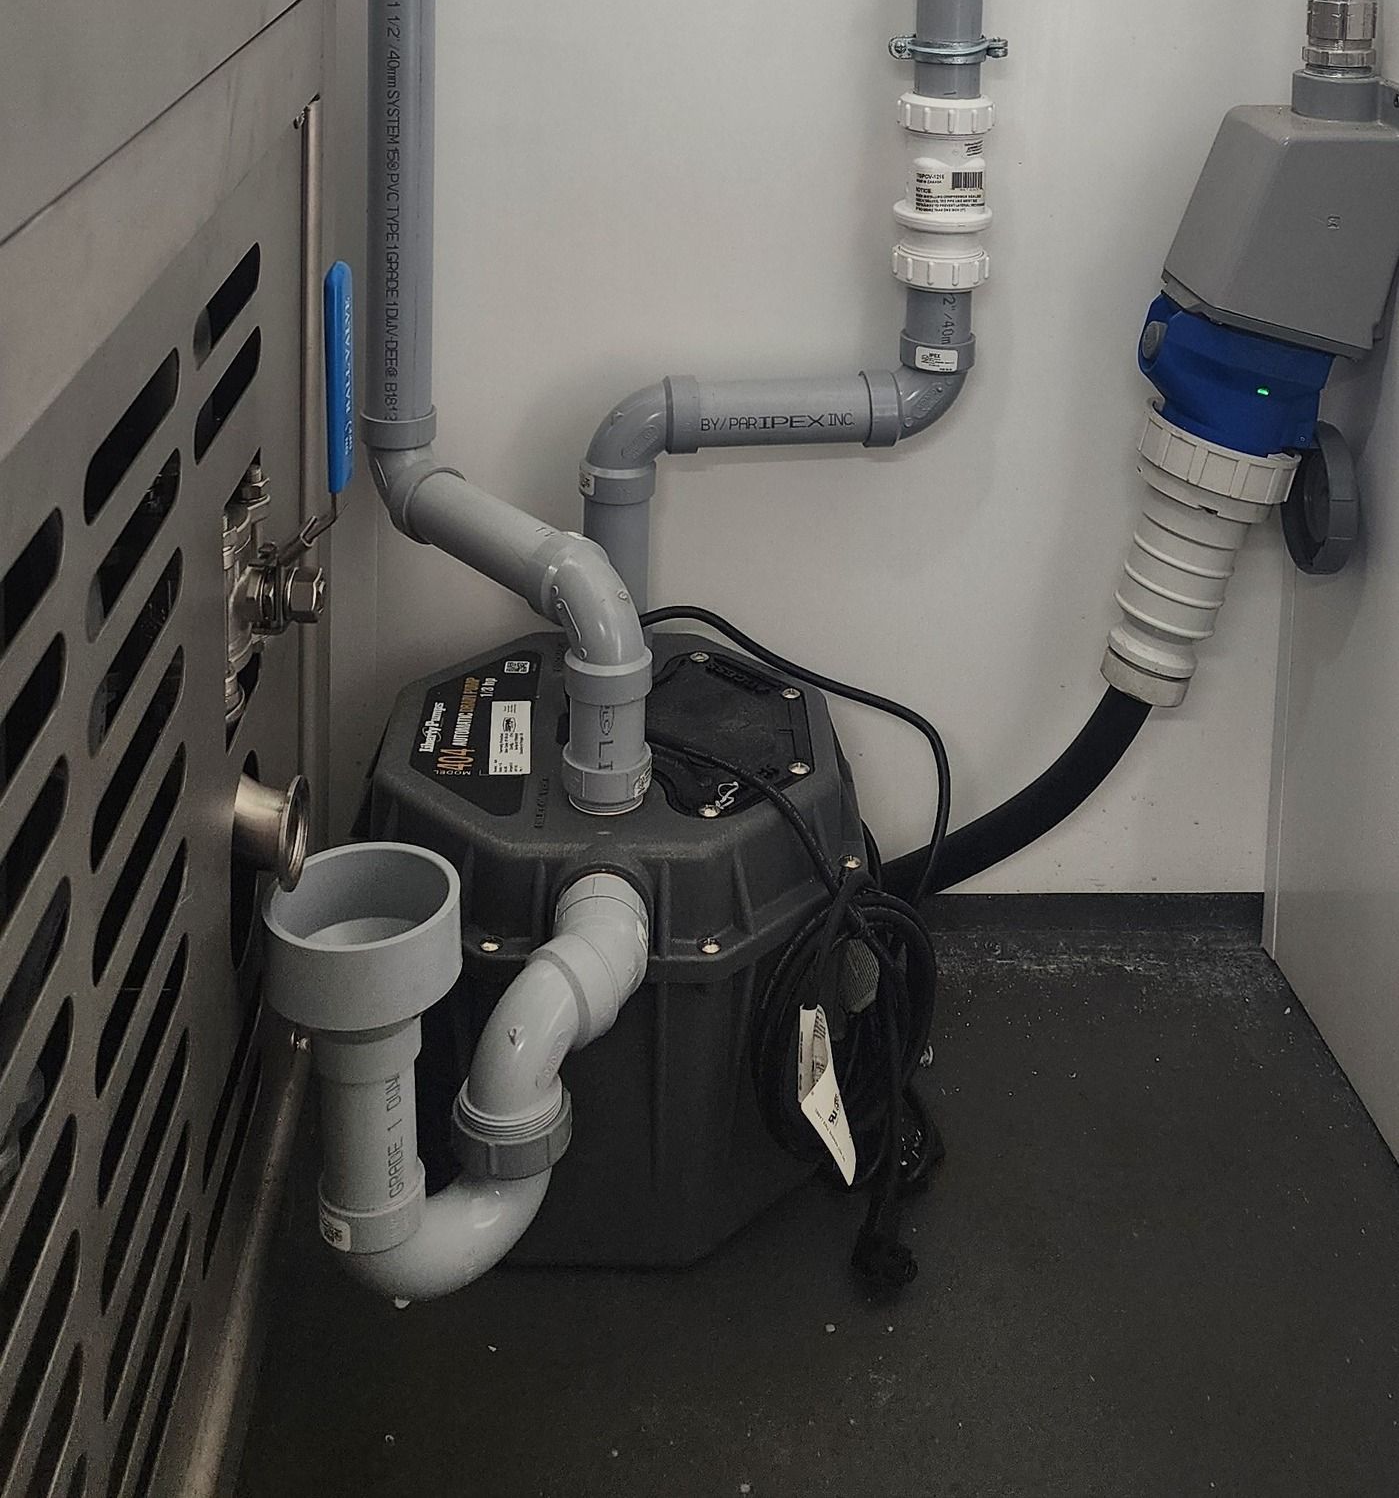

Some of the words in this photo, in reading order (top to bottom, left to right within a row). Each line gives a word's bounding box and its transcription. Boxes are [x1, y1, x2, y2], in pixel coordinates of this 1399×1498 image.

[386, 90, 401, 145] SYSTEM
[385, 173, 401, 202] PVC
[385, 206, 400, 242] TYPE
[384, 252, 400, 298] GRADE
[758, 414, 825, 430] IPEX
[479, 686, 495, 698] 1/3
[425, 701, 446, 727] Pumps
[418, 726, 441, 753] Liberty
[451, 711, 474, 747] AUTOMATIC
[433, 768, 472, 776] MODEL
[436, 748, 476, 771] 404
[386, 1118, 403, 1132] 1
[387, 1136, 405, 1199] GRADE
